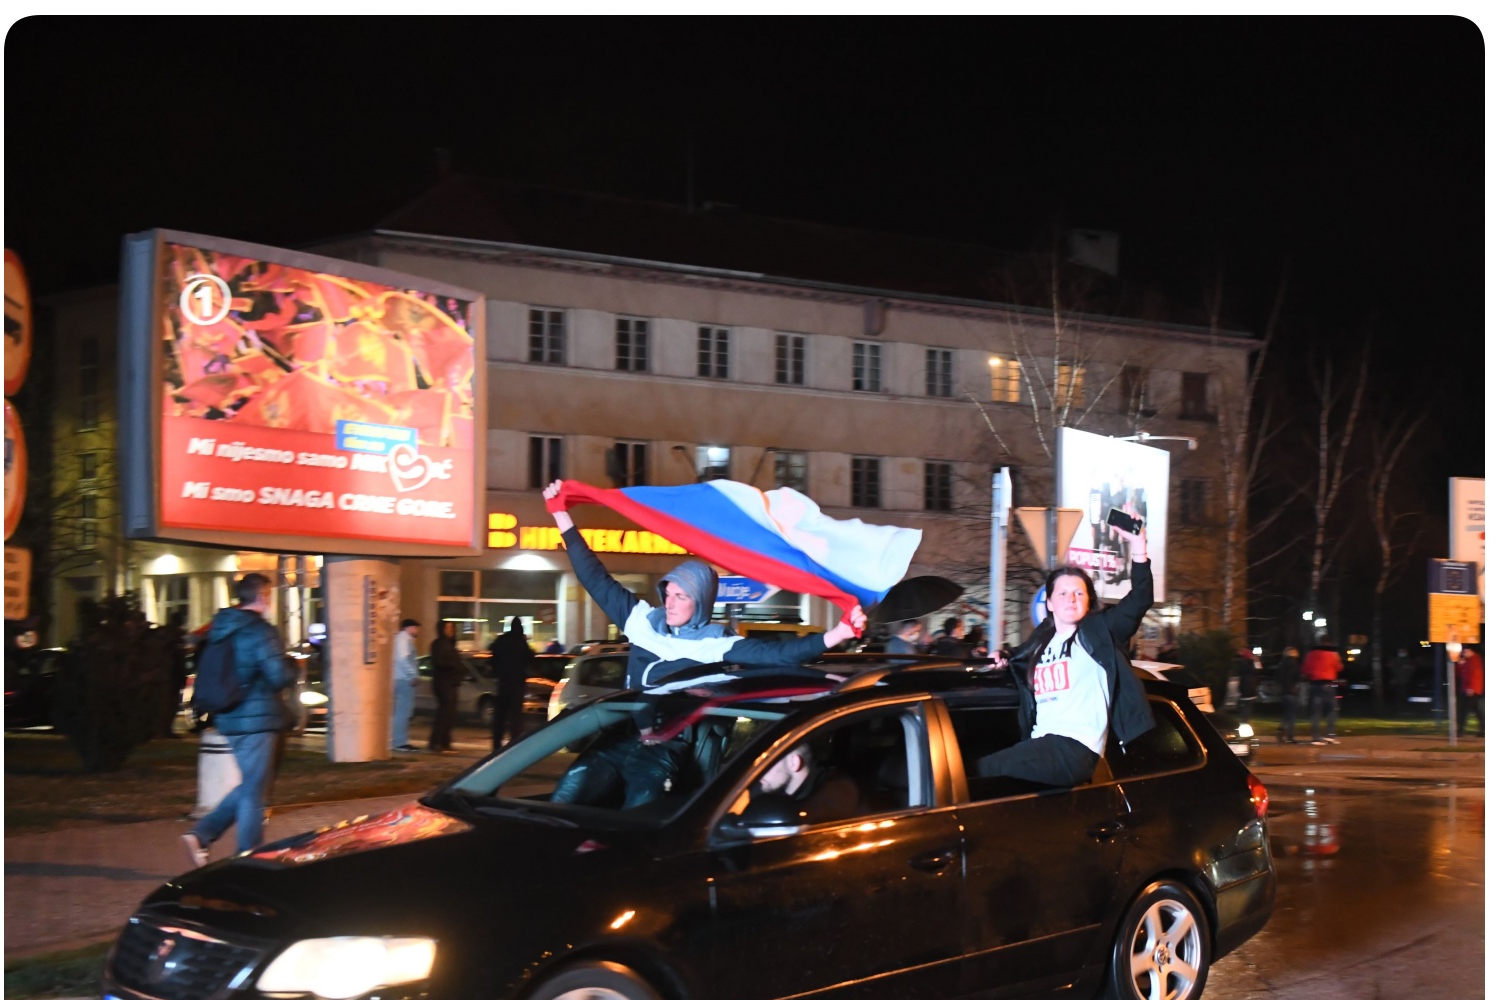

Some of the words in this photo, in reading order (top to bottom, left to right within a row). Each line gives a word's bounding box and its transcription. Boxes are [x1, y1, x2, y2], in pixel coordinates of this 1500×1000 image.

[188, 437, 216, 456] Mi
[216, 442, 295, 464] nijesmo
[297, 451, 348, 469] samo
[182, 481, 211, 500] Mi
[211, 487, 255, 503] smo
[258, 487, 335, 510] SNAGA
[338, 493, 396, 515] CRNE
[396, 497, 457, 519] GORE.
[519, 525, 693, 556] HIPTEKARN
